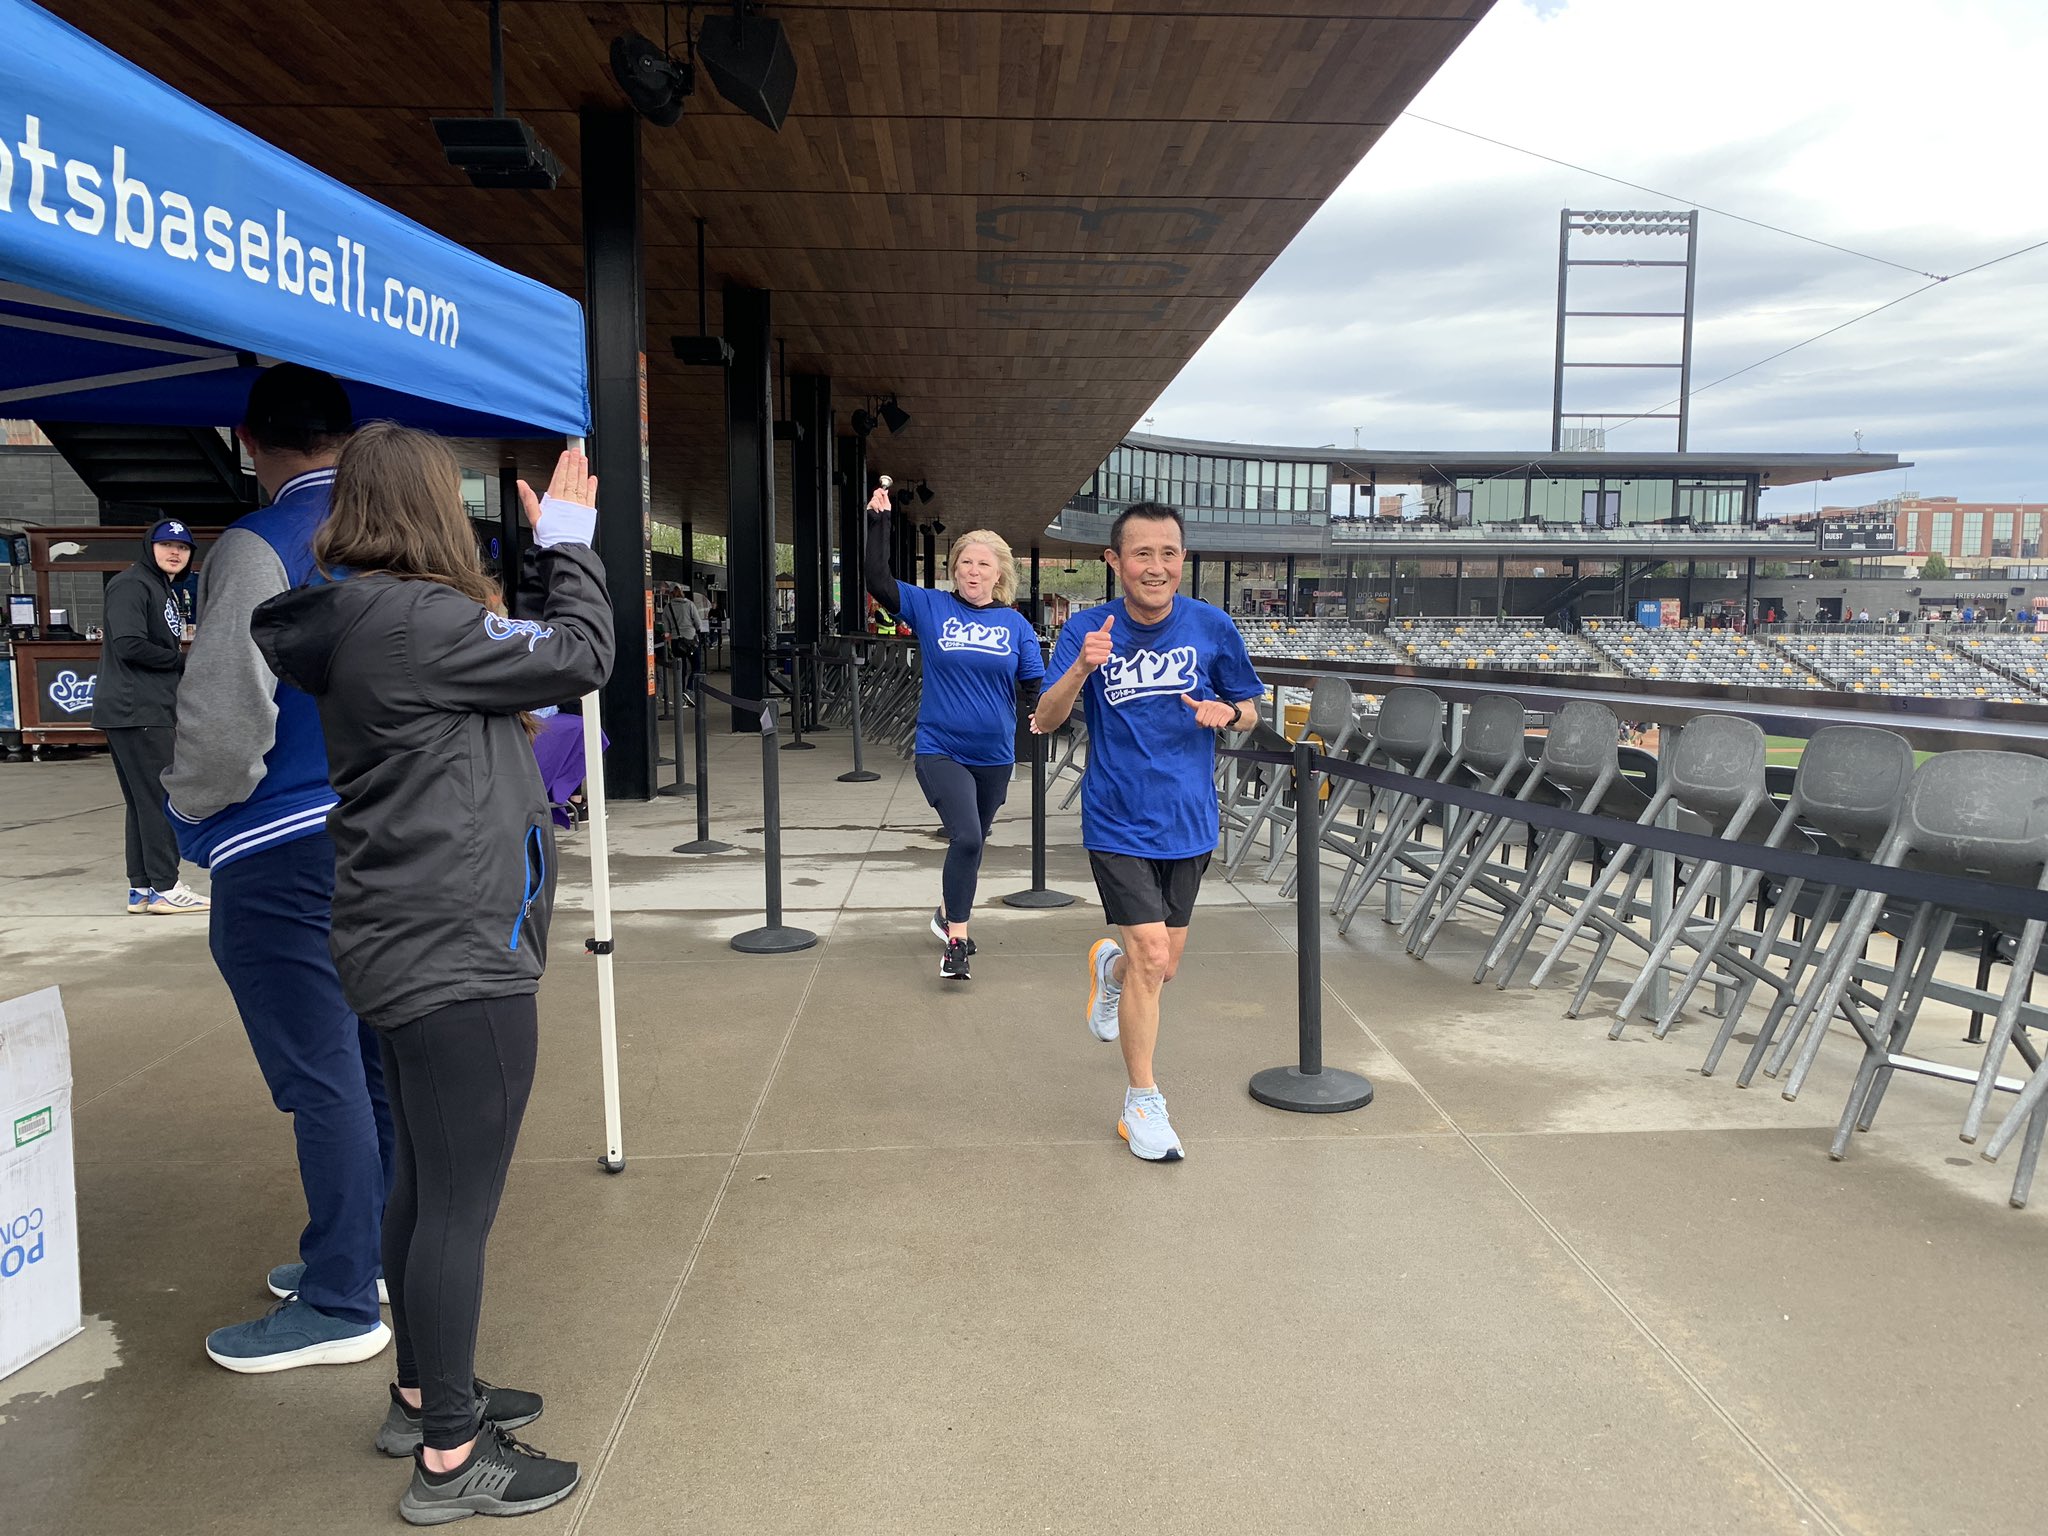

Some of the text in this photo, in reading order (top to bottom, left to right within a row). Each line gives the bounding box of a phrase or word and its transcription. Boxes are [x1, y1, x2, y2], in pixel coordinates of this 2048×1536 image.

[1824, 532, 1893, 540] GUEST SAINTS
[944, 618, 1009, 648] セインツ
[1103, 649, 1196, 685] セインツ
